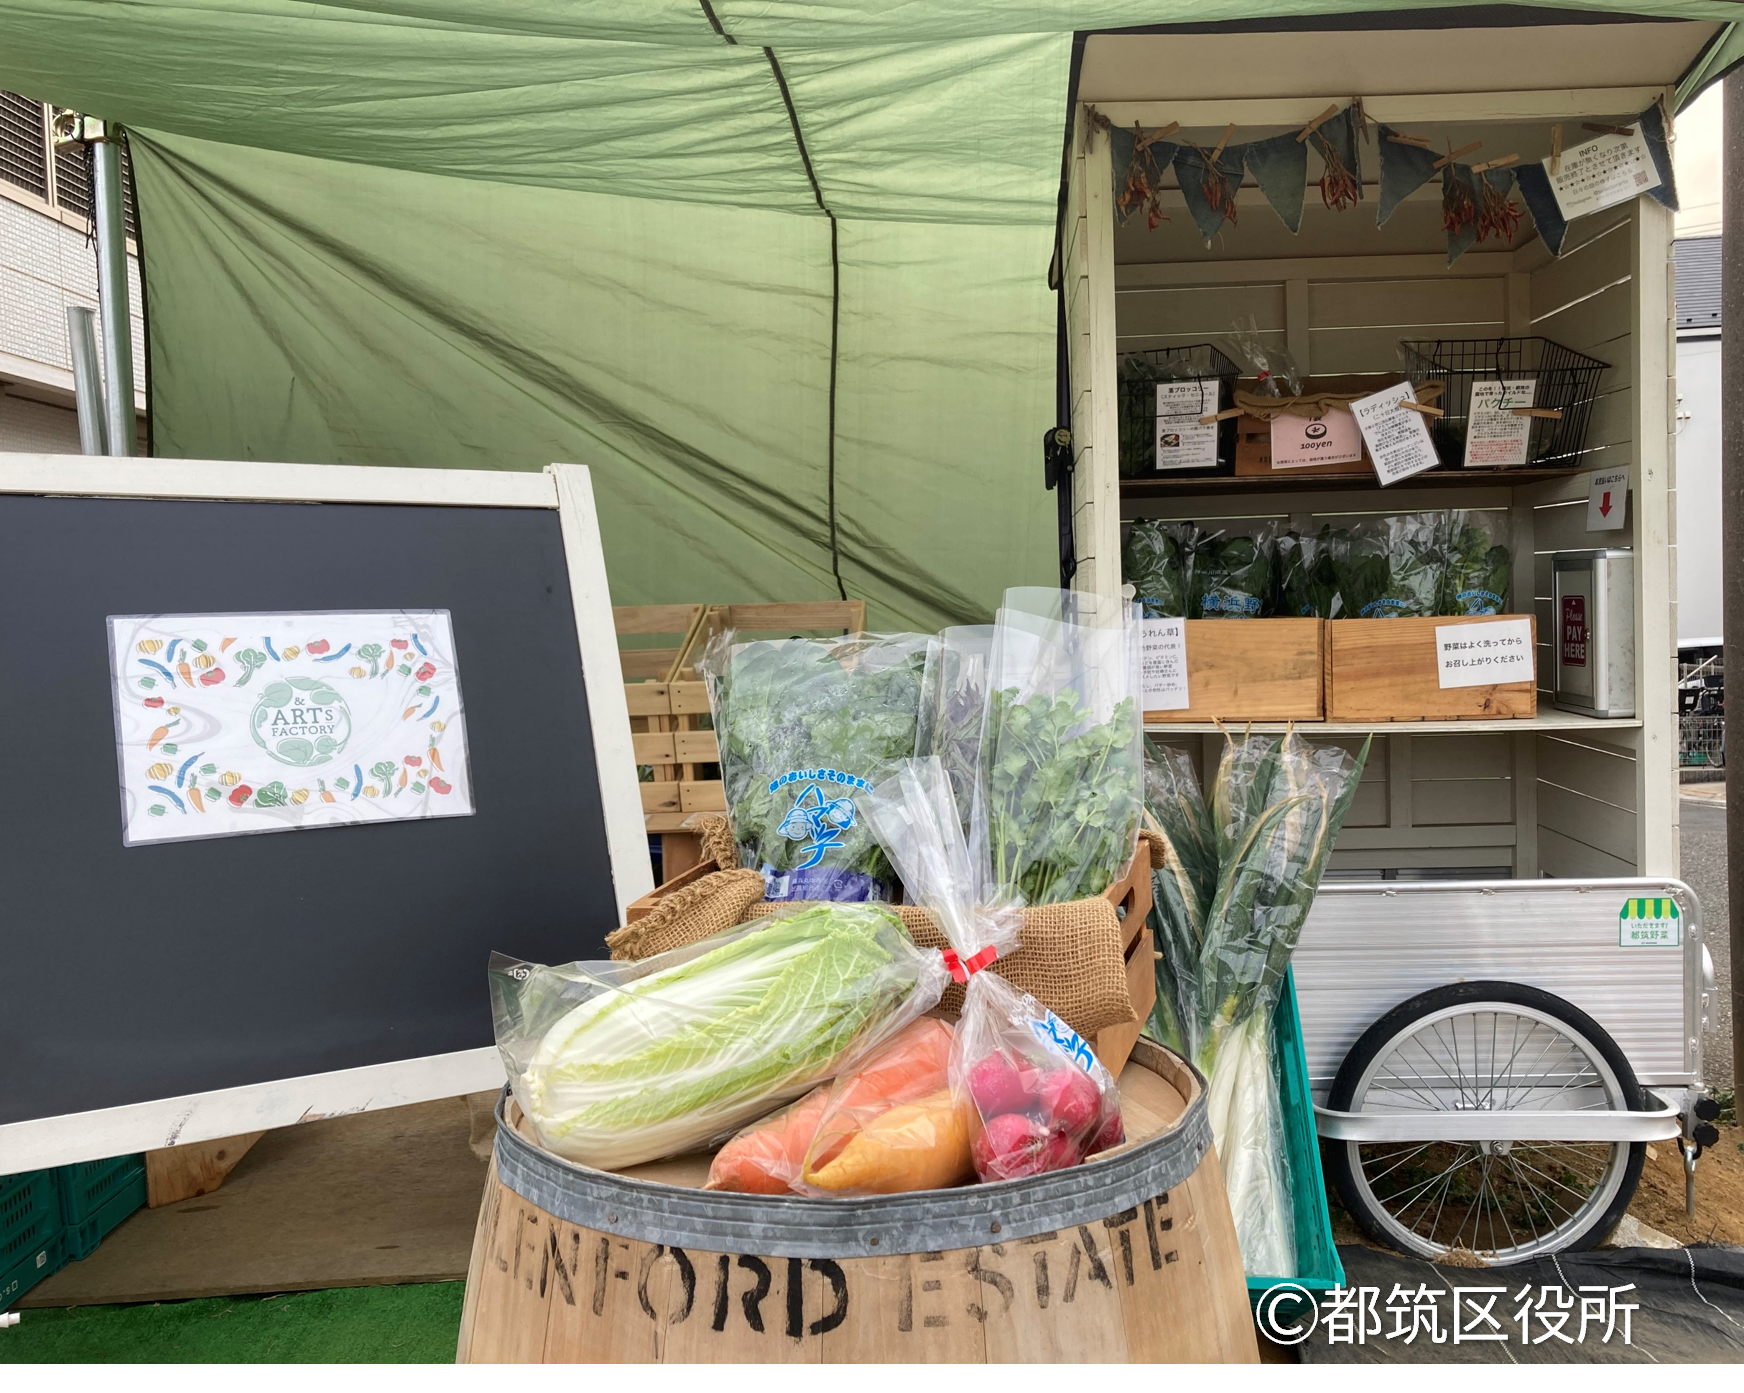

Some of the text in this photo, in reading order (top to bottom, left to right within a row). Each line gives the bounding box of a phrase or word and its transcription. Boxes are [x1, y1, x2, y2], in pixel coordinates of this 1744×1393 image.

[1564, 142, 1629, 173] 在庫が無くなり次第
[1578, 144, 1599, 158] INFO
[1555, 146, 1642, 184] 販売終了とさせて頂きます
[1300, 440, 1332, 450] 100yen
[1201, 592, 1262, 613] 横浜野
[1565, 608, 1583, 622] Please
[1566, 625, 1582, 641] PAY
[1444, 637, 1522, 651] 野菜はよく洗ってから
[1564, 643, 1585, 659] HERE
[1445, 655, 1524, 668] お召し上がりください
[294, 697, 306, 706] &
[271, 724, 335, 737] FACTORY
[769, 768, 875, 796] 畑のおいしさそのままに
[1630, 930, 1668, 940] 都筑野菜
[898, 1192, 1180, 1332] ESTATE
